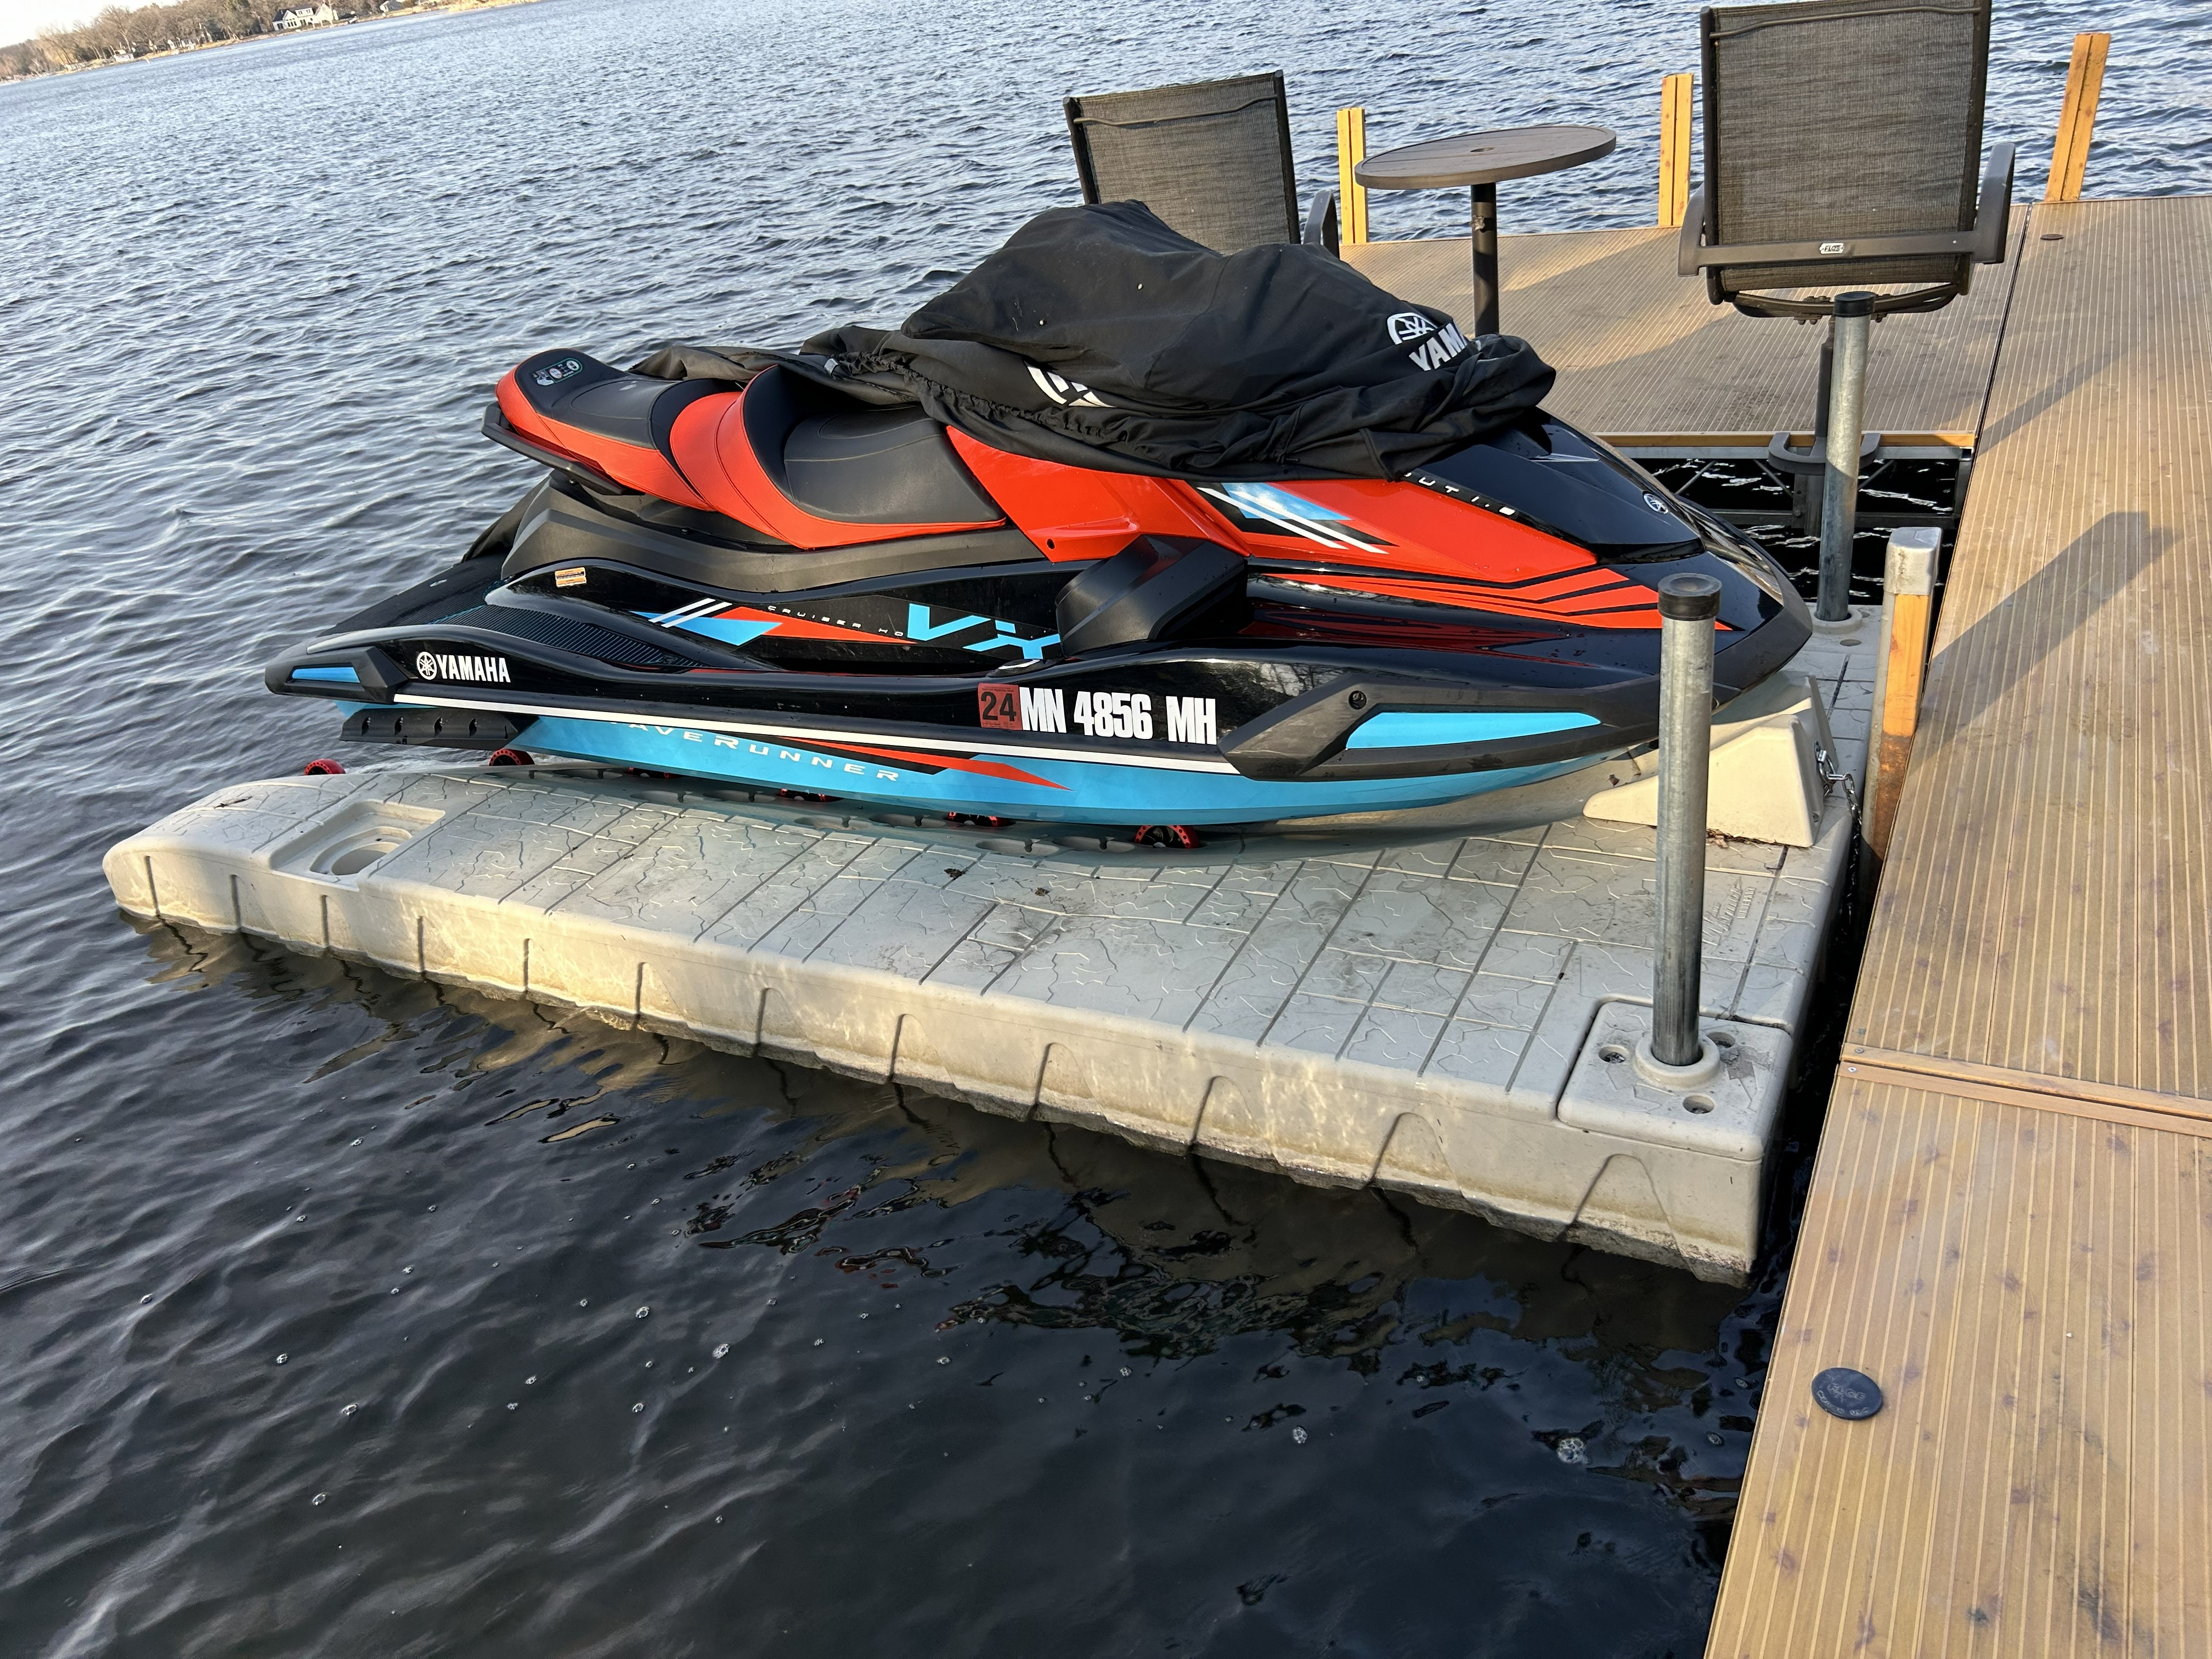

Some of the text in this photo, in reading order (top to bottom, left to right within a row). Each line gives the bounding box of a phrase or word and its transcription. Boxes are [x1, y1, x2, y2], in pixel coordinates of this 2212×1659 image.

[1409, 323, 1468, 372] YAM
[768, 605, 862, 629] CRUISER
[435, 654, 511, 683] YAMAHA
[981, 691, 1017, 722] 24
[1019, 686, 1217, 745] MN 4856 MH
[610, 722, 900, 782] AVERUNNER
